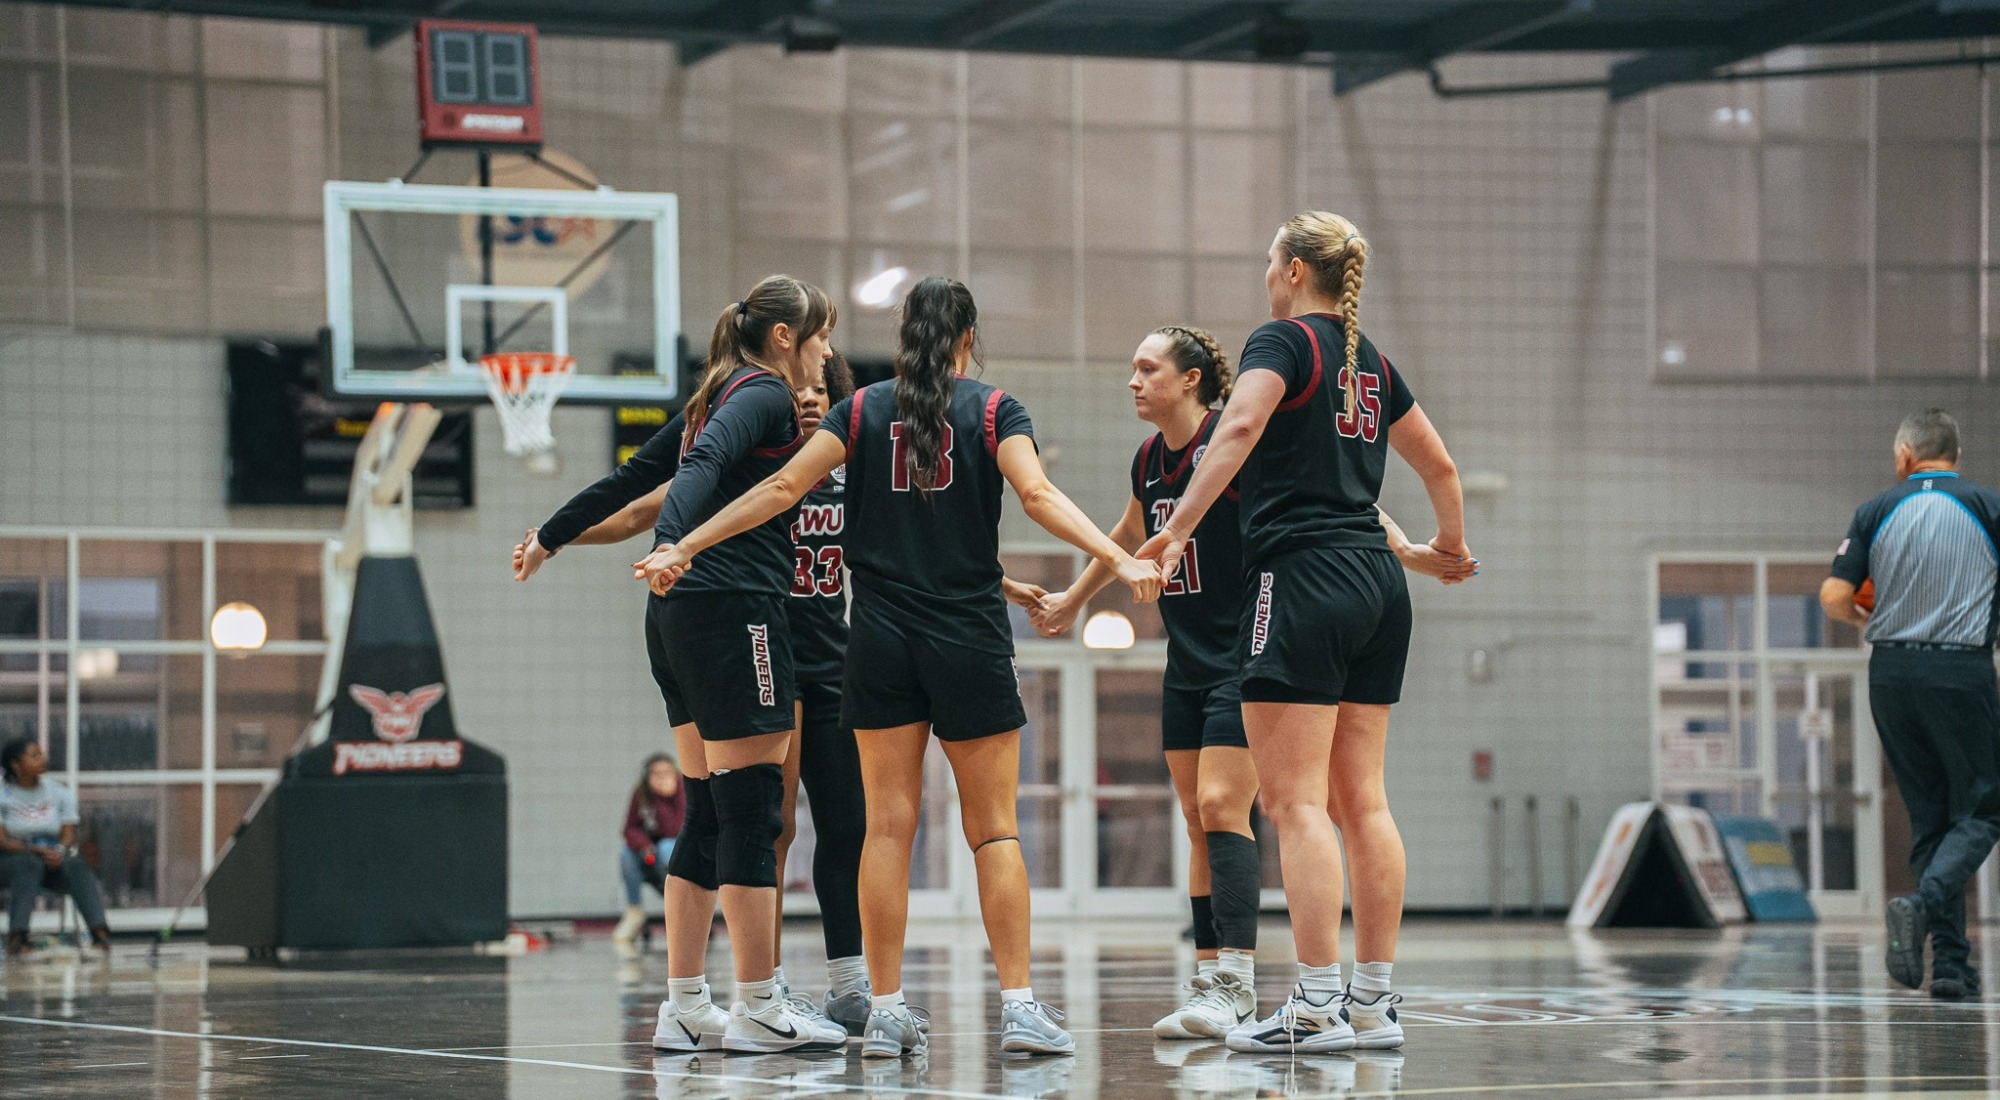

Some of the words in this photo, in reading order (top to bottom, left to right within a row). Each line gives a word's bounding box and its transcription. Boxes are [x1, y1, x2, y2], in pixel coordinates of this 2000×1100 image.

[1336, 366, 1382, 443] 35
[799, 503, 845, 537] WU
[790, 545, 844, 597] 33
[1251, 572, 1274, 657] PIONEERS
[747, 623, 775, 707] PIONEERS
